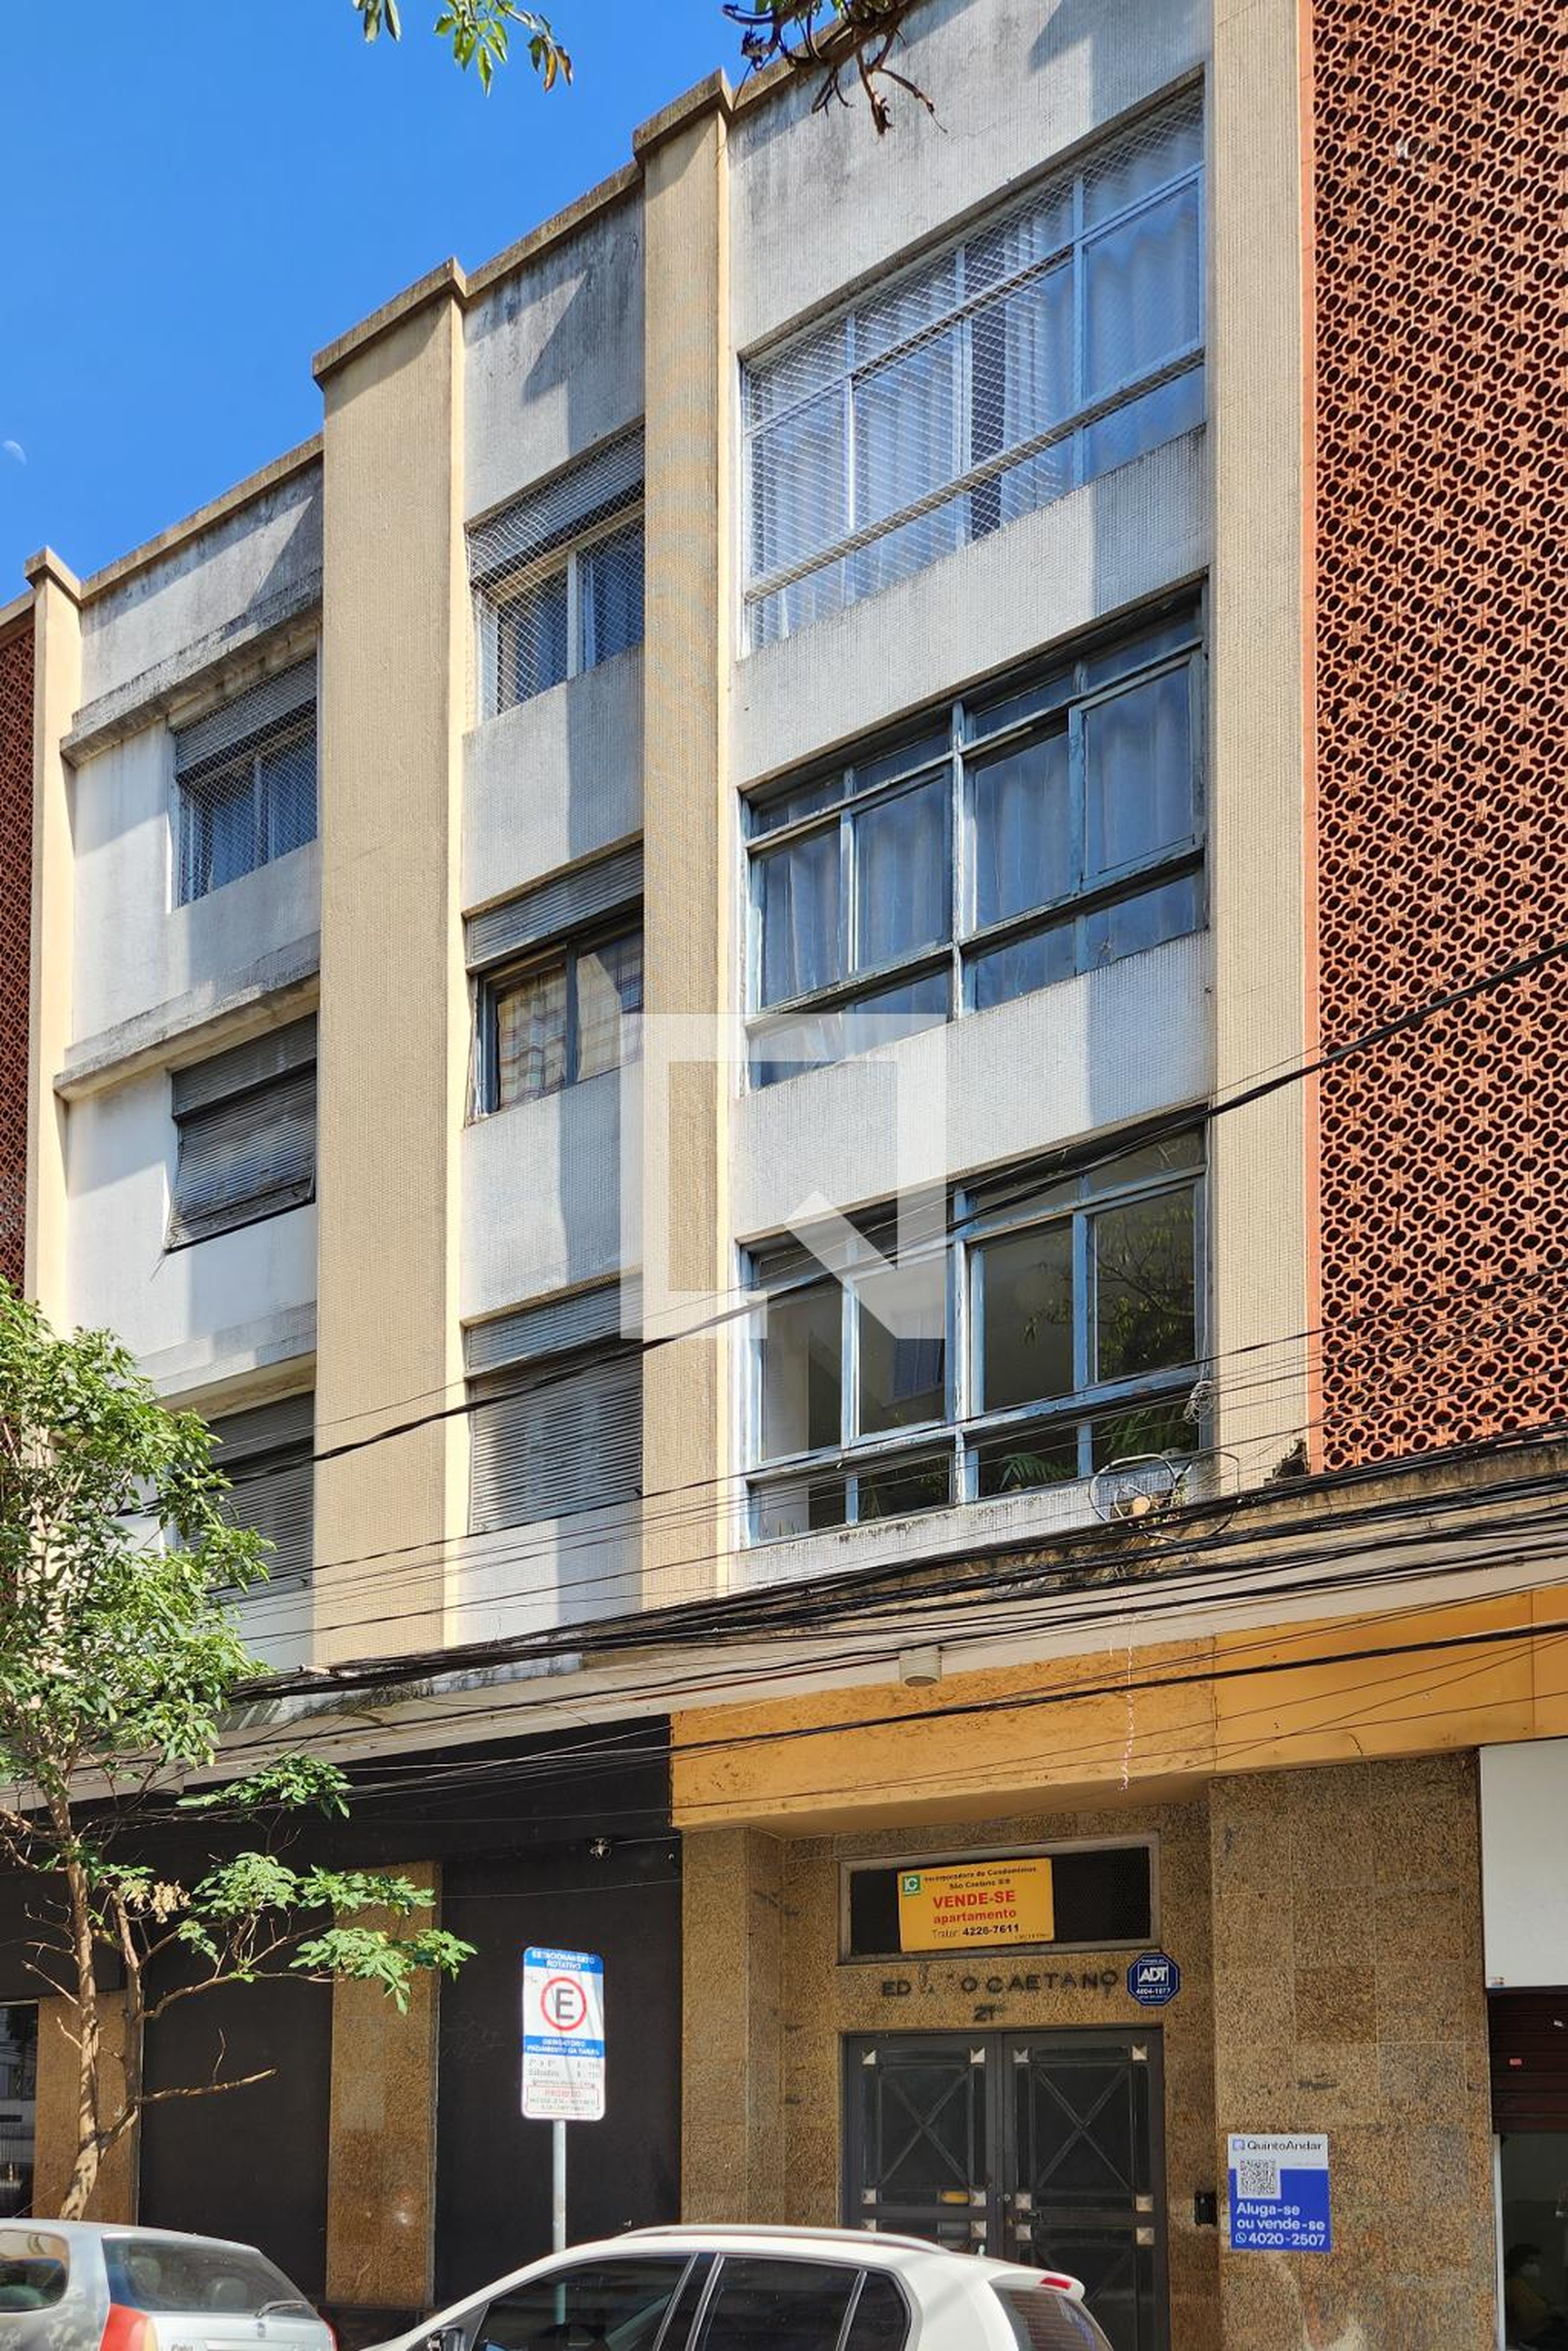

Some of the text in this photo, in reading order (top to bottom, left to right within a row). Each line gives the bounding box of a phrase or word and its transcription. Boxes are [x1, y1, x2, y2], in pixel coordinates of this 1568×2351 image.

[933, 1890, 1016, 1909] VENDE-SE
[933, 1909, 1017, 1925] apartamento
[1138, 1966, 1168, 1982] ADT
[555, 1988, 574, 2020] E
[1247, 2140, 1322, 2150] QuintoAndar
[1236, 2202, 1300, 2217] Aluga-se
[1236, 2218, 1325, 2231] ou vende-se
[1248, 2233, 1325, 2246] 4020-2507
